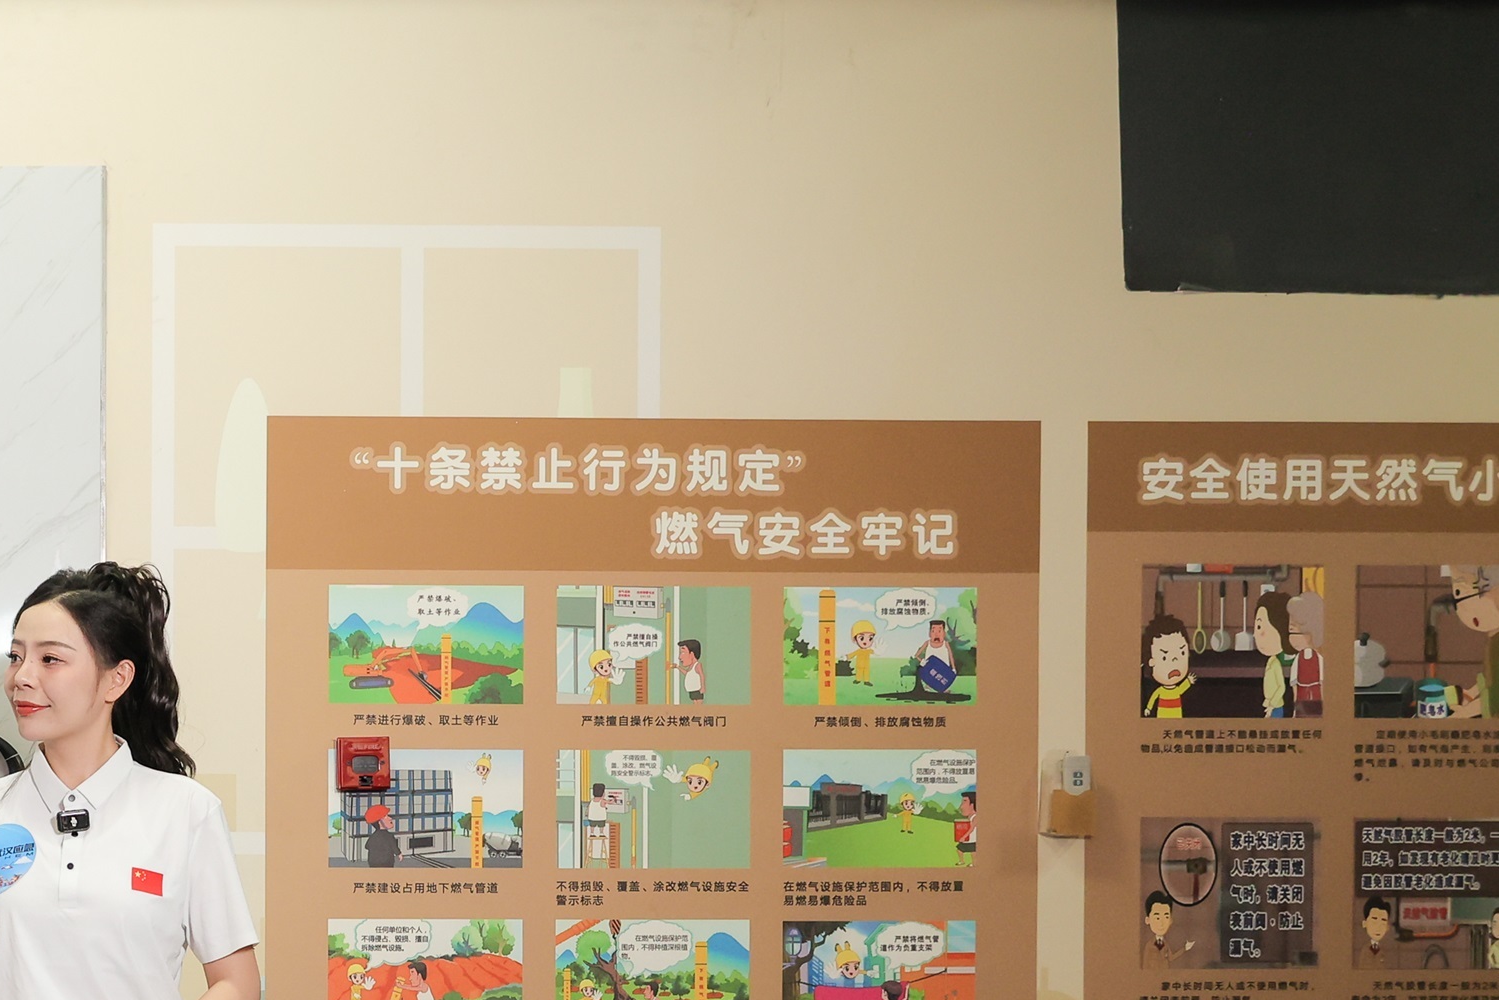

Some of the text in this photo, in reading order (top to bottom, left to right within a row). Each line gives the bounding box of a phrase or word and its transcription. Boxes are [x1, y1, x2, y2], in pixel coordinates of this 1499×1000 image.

[351, 445, 804, 492] “十条禁止行为规定”
[654, 510, 957, 556] 燃气安全牢记
[417, 607, 462, 616] 取土等作业
[626, 632, 659, 641] 严禁擅自操
[613, 640, 658, 648] 作公共燃气阀门
[353, 713, 499, 727] 严禁进行爆破、取土等作业
[581, 715, 727, 728] 严禁擅自操作公共燃气阀门
[814, 716, 947, 728] 严禁倾倒、排放腐蚀物质
[1230, 830, 1305, 850] 家中长时间无
[1230, 858, 1305, 877] 人或不使用燃
[353, 882, 499, 894] 严禁建设占用地下燃气管道
[556, 880, 750, 893] 不得损毁、覆盖、涂改燃气设施安全
[783, 880, 964, 893] 在燃气设施保护范围内，不得放置
[556, 894, 604, 906] 警示标志
[783, 894, 867, 906] 易燃易爆危险品
[1230, 884, 1304, 904] 气时，请关闭
[894, 935, 940, 943] 严禁将燃气管
[880, 944, 933, 952] 道作为负重支架
